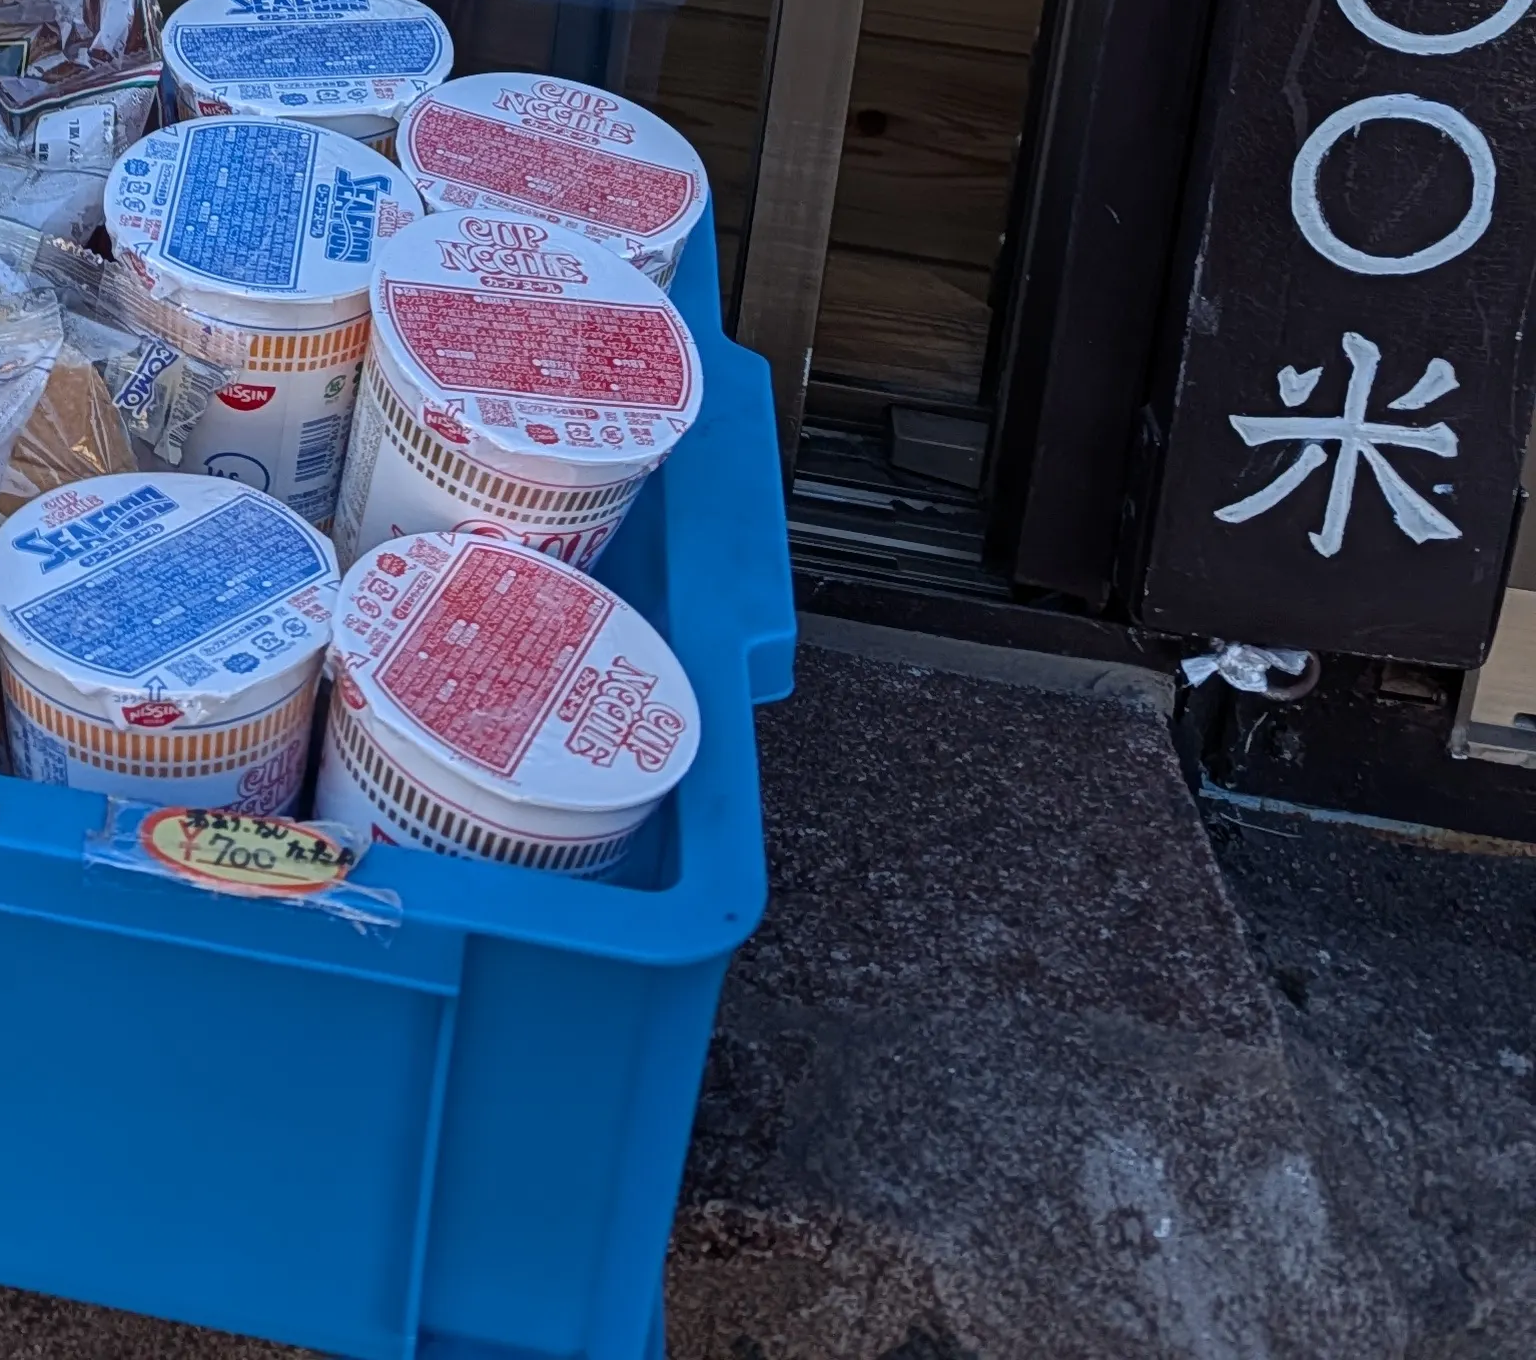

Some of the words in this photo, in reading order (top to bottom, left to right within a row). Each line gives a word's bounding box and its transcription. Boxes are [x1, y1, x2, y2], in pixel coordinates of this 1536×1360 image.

[531, 80, 620, 116] CUP
[458, 216, 549, 251] CUP
[11, 483, 180, 576] SEAFOOD
[624, 701, 687, 773] CUP
